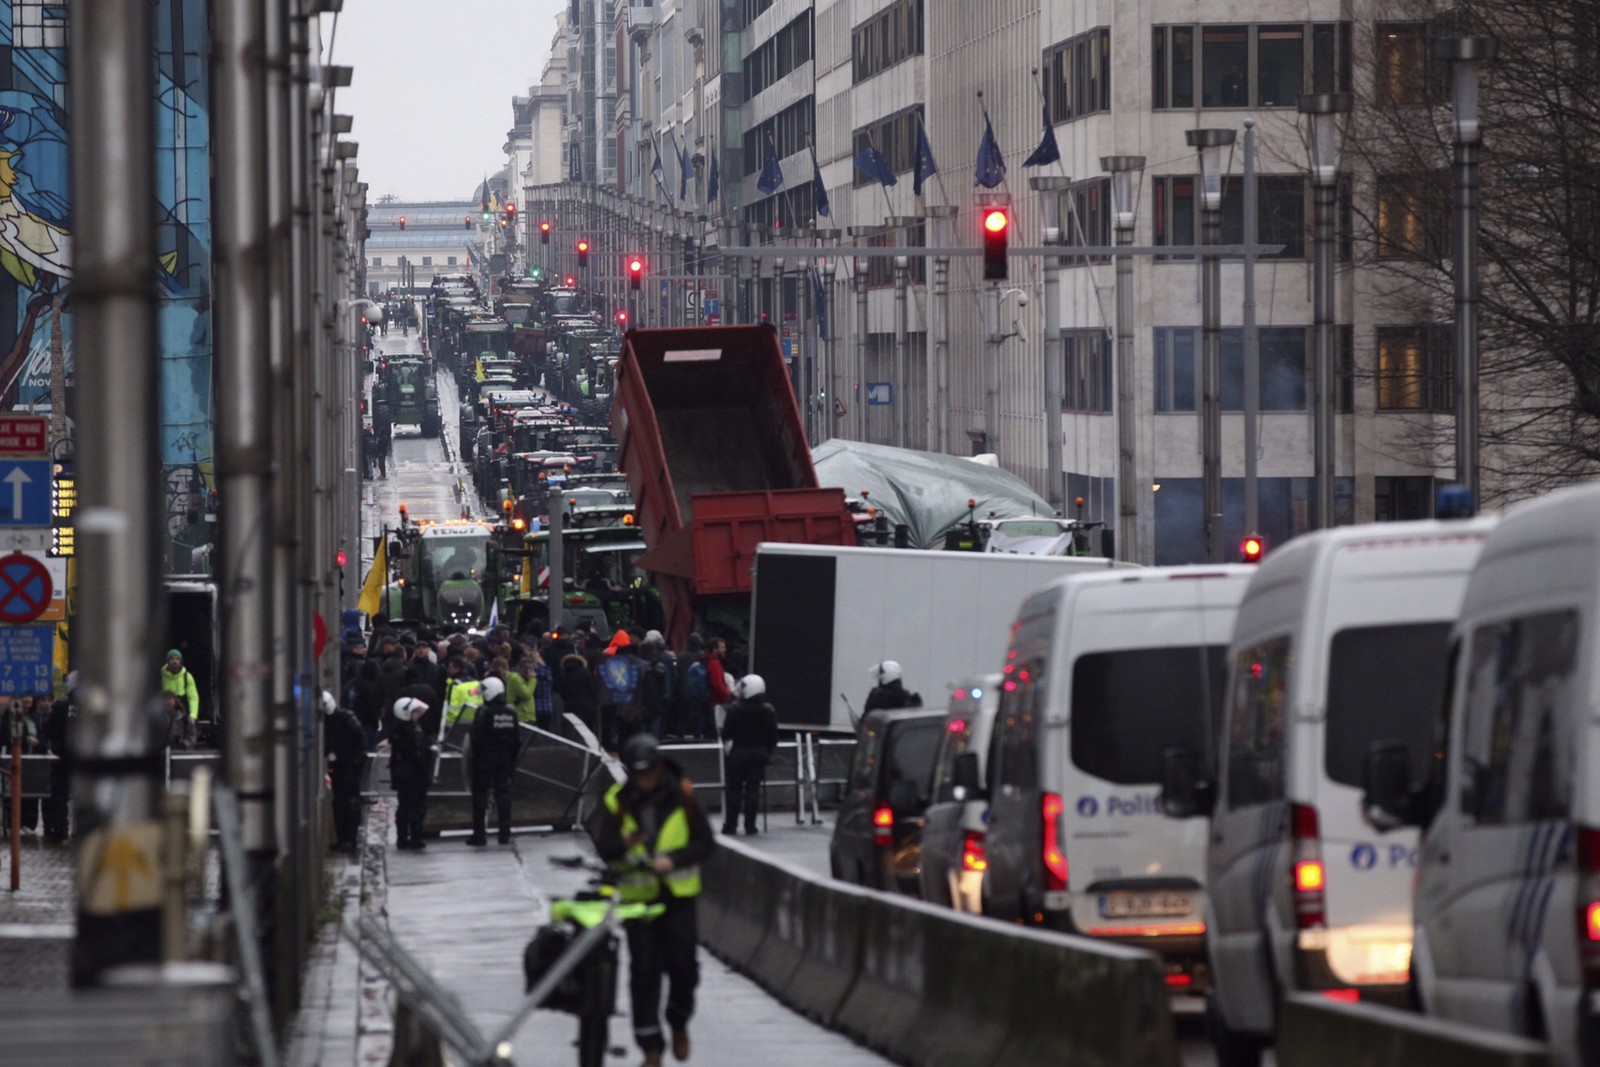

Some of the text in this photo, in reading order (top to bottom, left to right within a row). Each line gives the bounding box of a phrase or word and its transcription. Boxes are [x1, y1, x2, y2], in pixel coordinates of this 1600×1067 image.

[3, 665, 12, 676] 7
[35, 665, 48, 677] 13
[1, 680, 15, 691] 16
